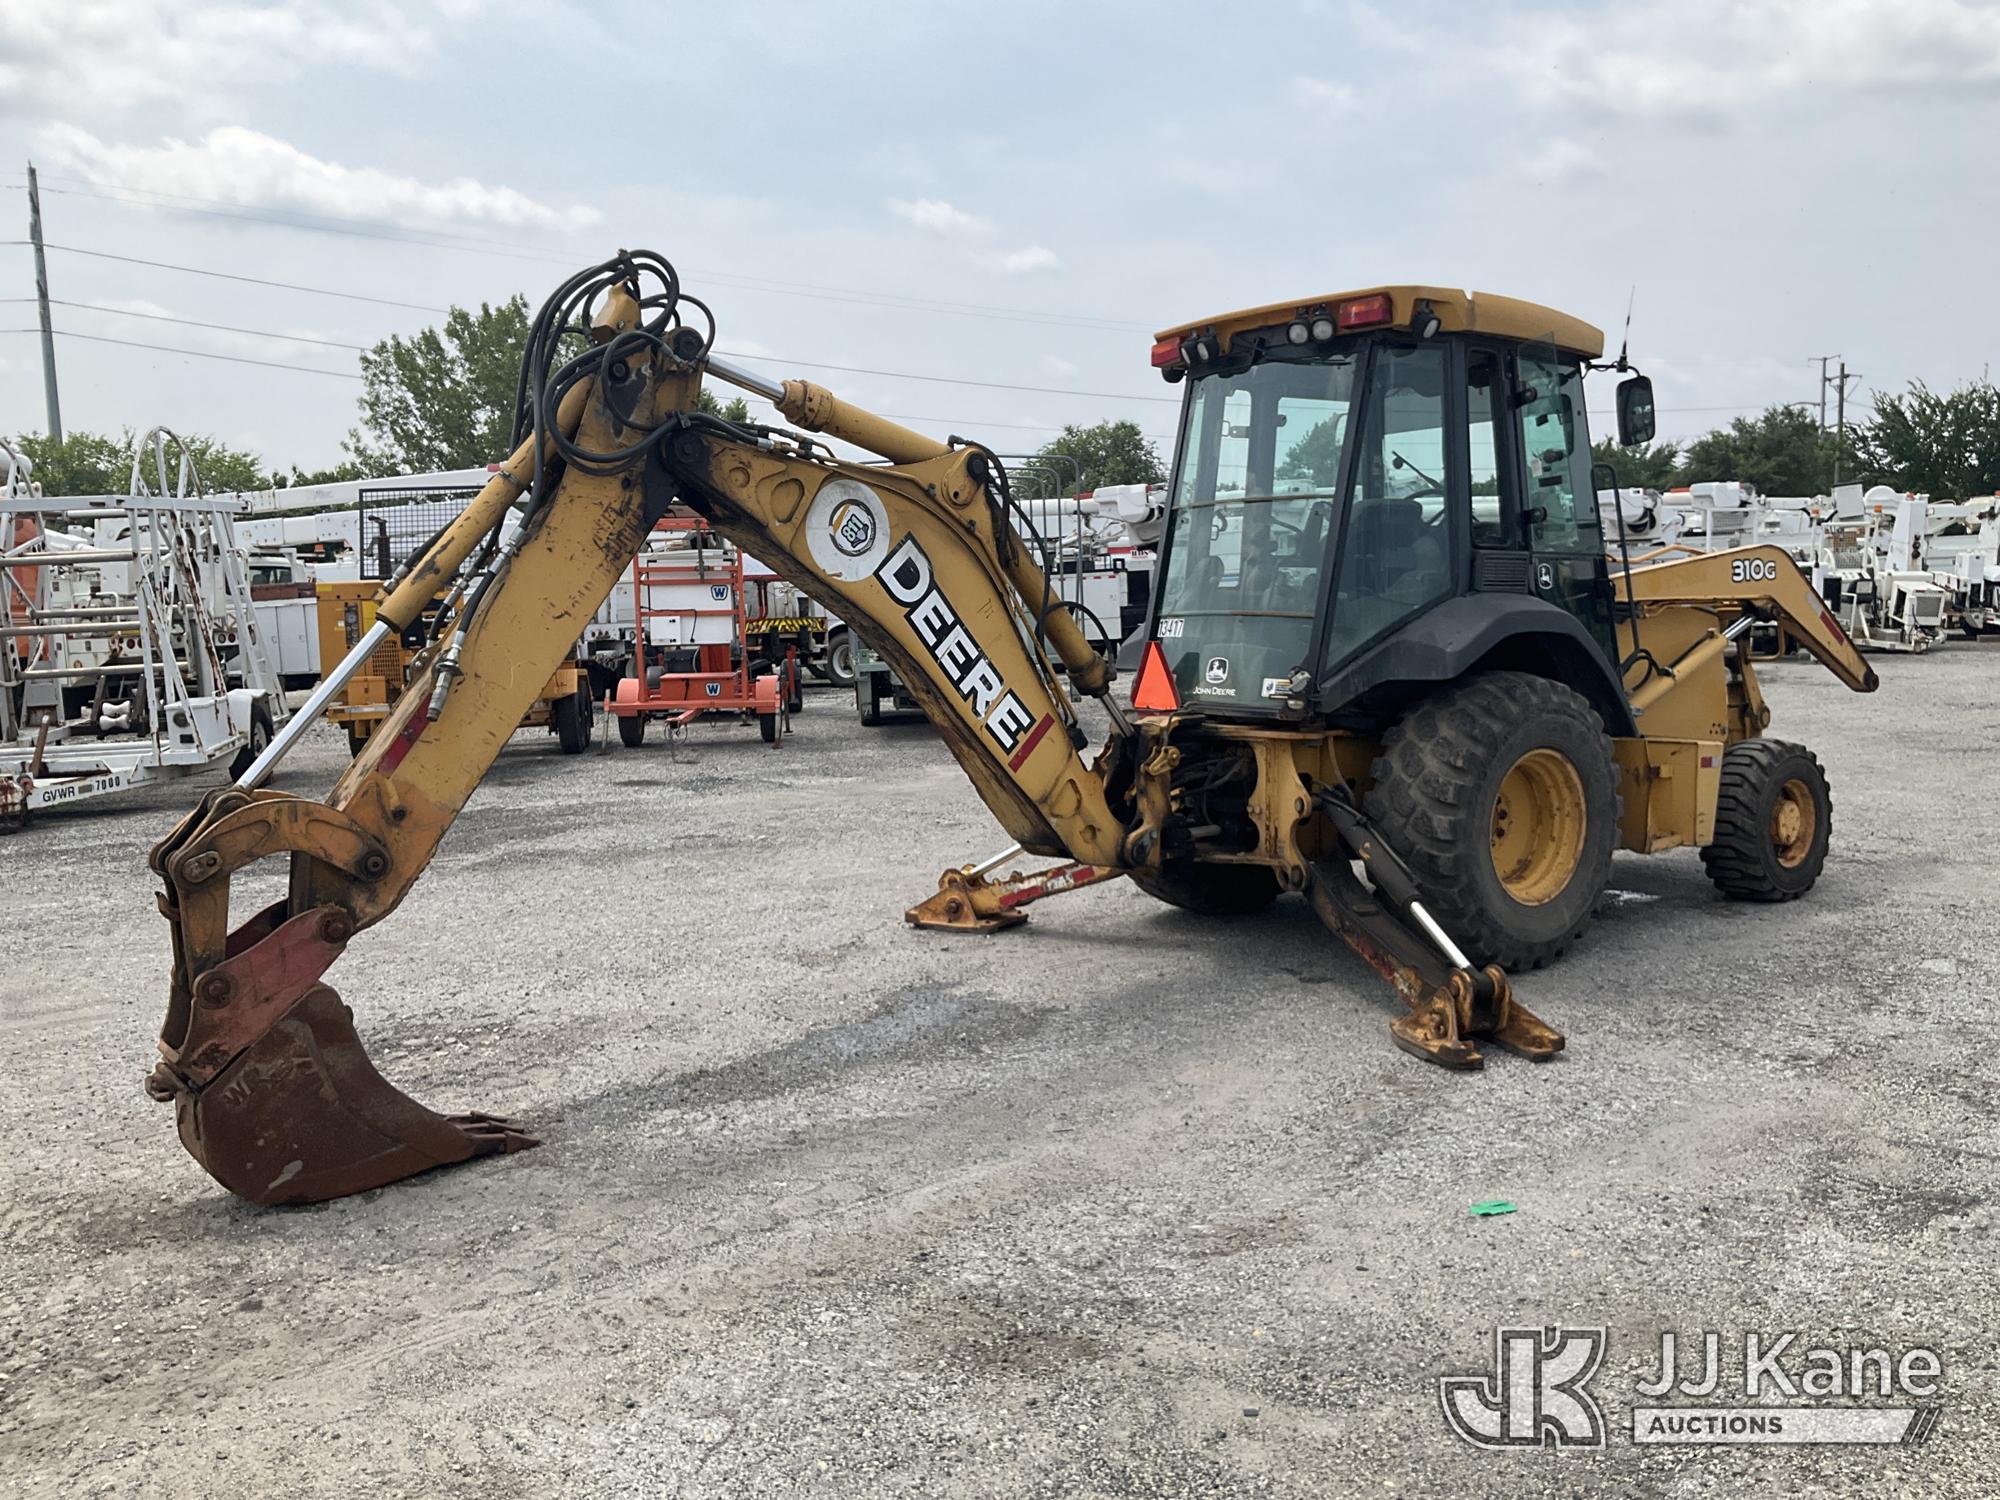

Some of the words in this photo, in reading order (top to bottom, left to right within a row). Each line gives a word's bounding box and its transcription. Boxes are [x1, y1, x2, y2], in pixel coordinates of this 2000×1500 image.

[840, 513, 864, 543] 811
[1731, 558, 1776, 582] 310G
[713, 586, 726, 598] W
[1158, 619, 1184, 637] 13417
[876, 536, 1034, 752] DEERE
[706, 684, 719, 696] W
[1192, 686, 1211, 696] JOHN
[1212, 686, 1237, 697] DEERE
[42, 786, 75, 802] GVWR
[95, 776, 120, 790] 7000
